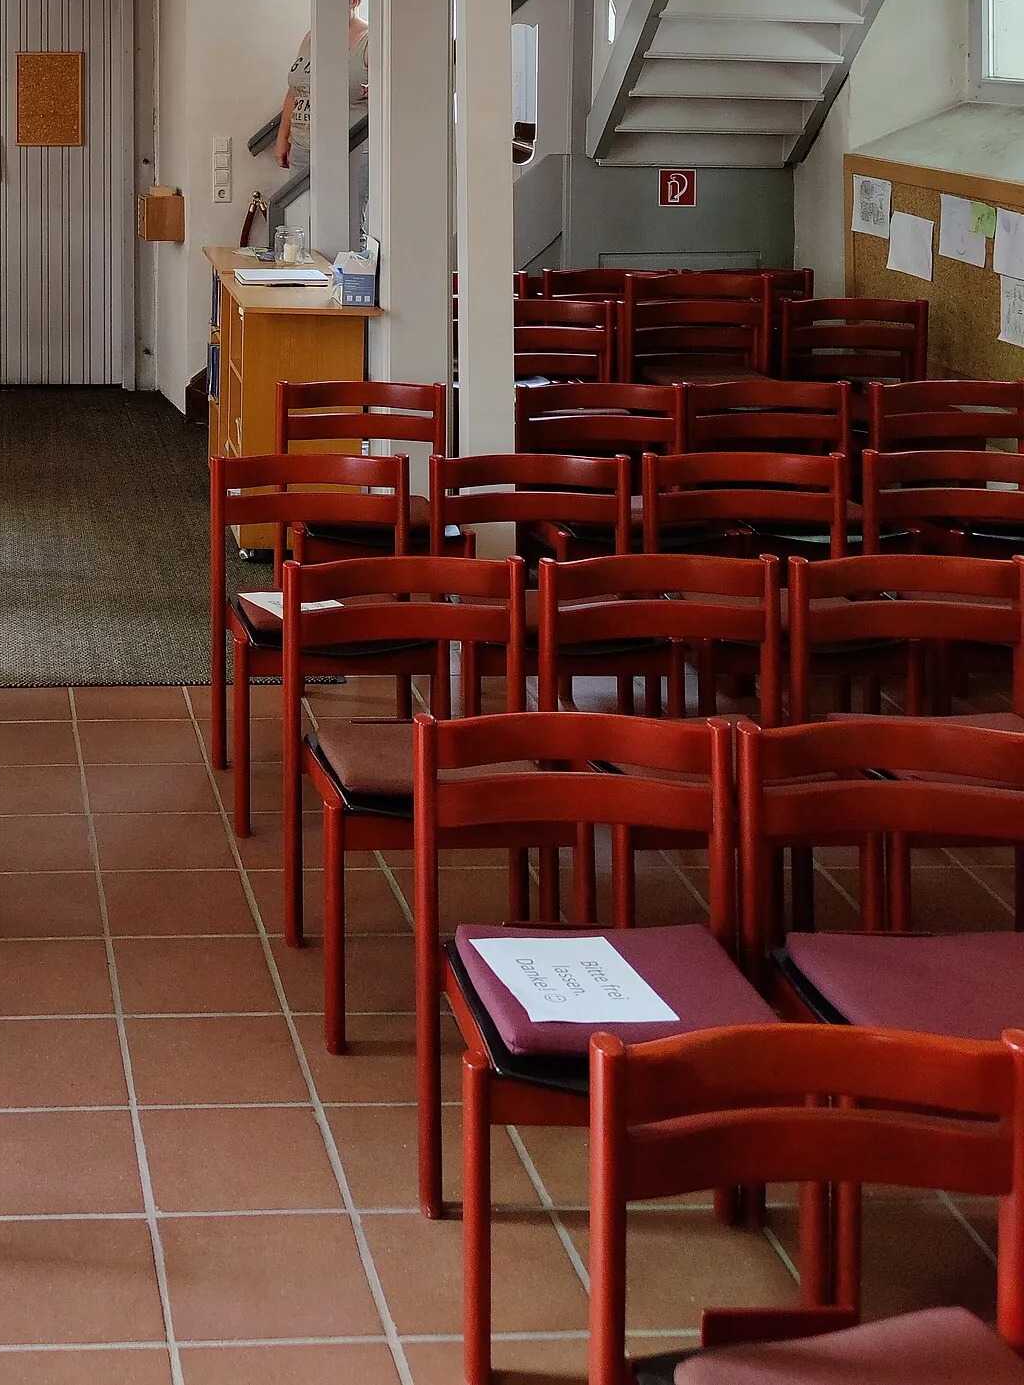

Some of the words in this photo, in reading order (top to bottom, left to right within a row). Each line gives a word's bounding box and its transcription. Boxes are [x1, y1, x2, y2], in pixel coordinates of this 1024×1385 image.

[516, 958, 557, 991] Danke!
[552, 965, 586, 996] lassen.
[580, 960, 608, 983] Bitte
[601, 983, 630, 1000] frei
